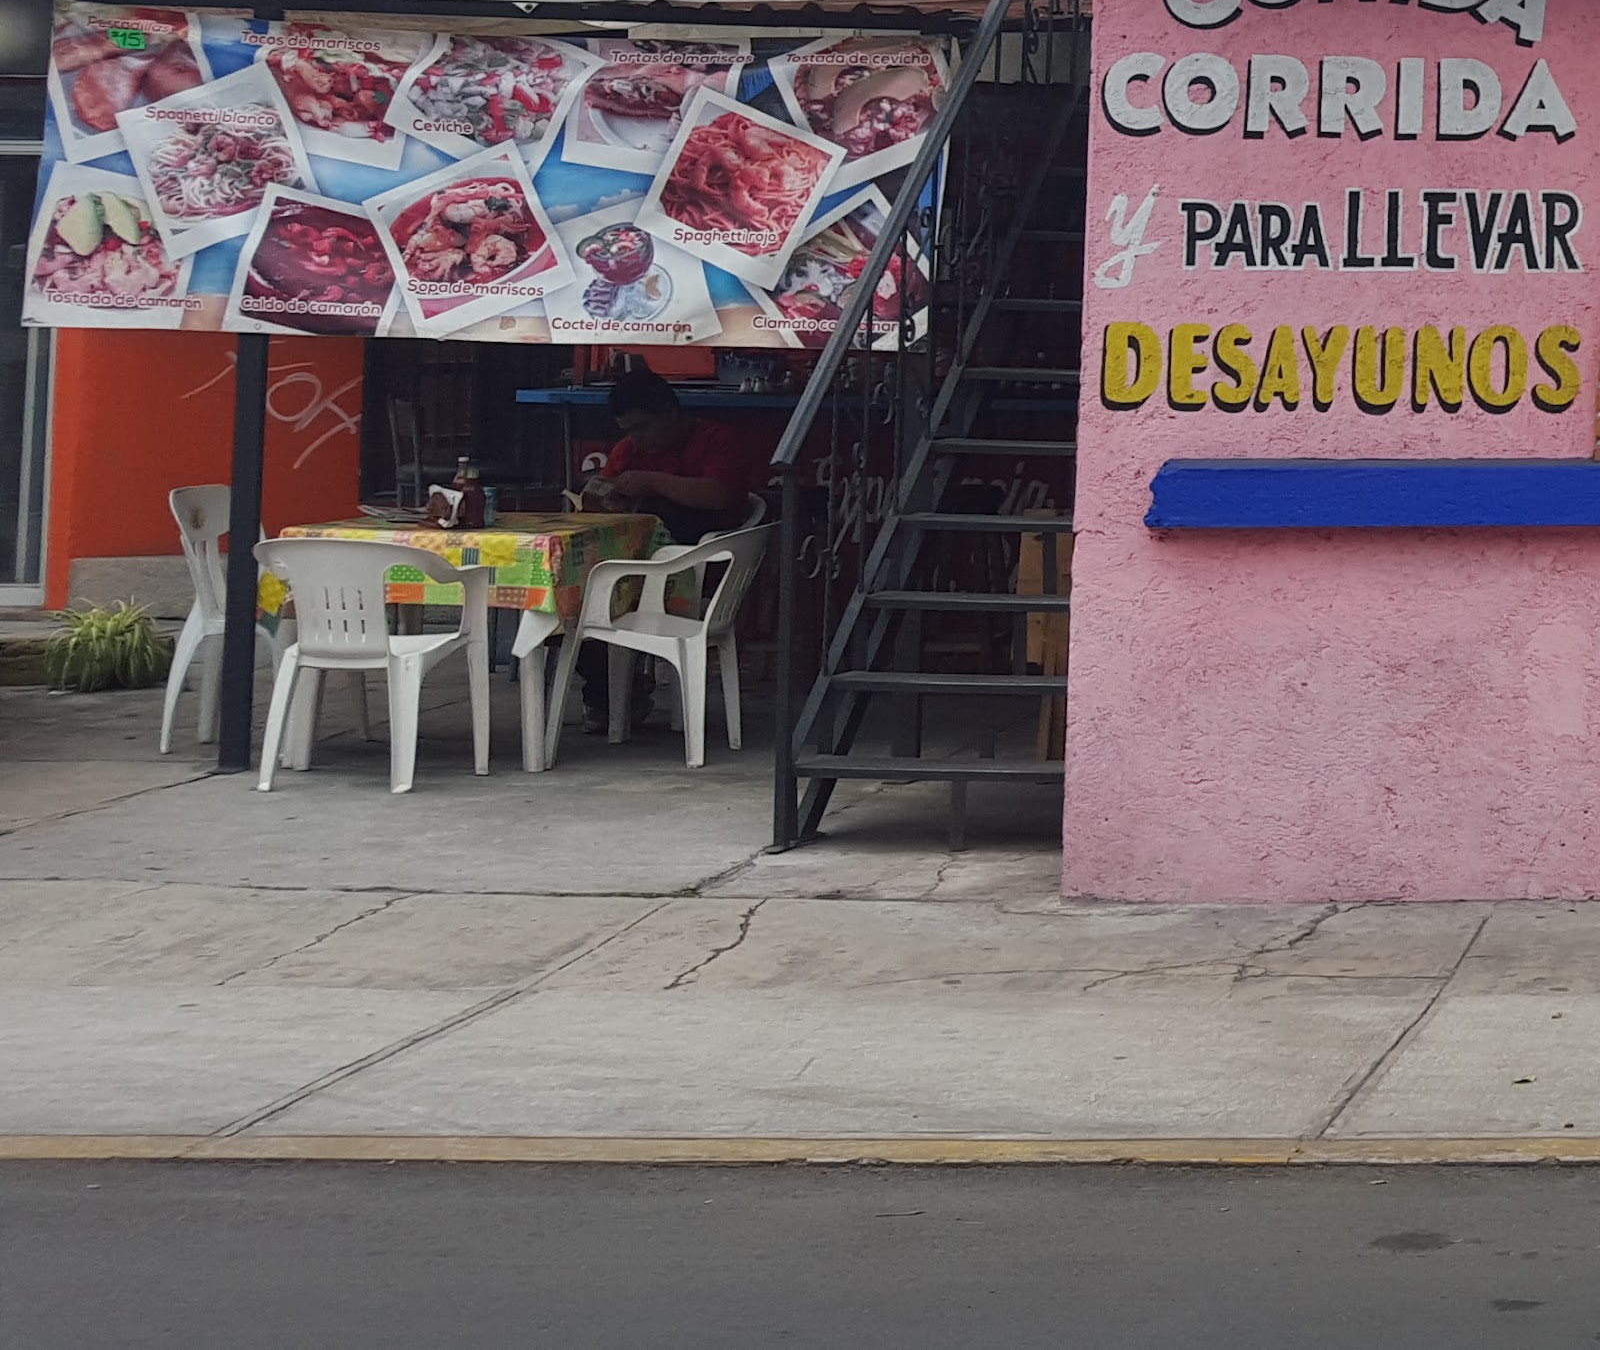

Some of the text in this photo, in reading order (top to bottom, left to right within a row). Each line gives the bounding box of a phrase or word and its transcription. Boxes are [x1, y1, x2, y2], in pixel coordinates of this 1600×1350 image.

[87, 16, 172, 33] Pescadillas
[241, 31, 381, 51] Tacos de mariscos
[610, 51, 754, 64] Tortas de mariscos
[786, 52, 930, 64] Tostada de ceviche
[1101, 52, 1578, 144] CORRIDA
[145, 107, 275, 125] Spaghetti blanco
[412, 119, 473, 134] Ceviche
[673, 229, 777, 247] Spaghetti rojo
[1178, 198, 1334, 271] PARA
[1338, 187, 1584, 275] LLEVAR
[407, 279, 544, 296] Sopa de mariscos
[46, 290, 202, 308] Tostada de camarón
[242, 296, 382, 316] Caldo de camarón
[551, 317, 692, 333] Coctel de camarón
[753, 316, 816, 330] Clamato
[1100, 321, 1582, 414] DESAYUNOS
